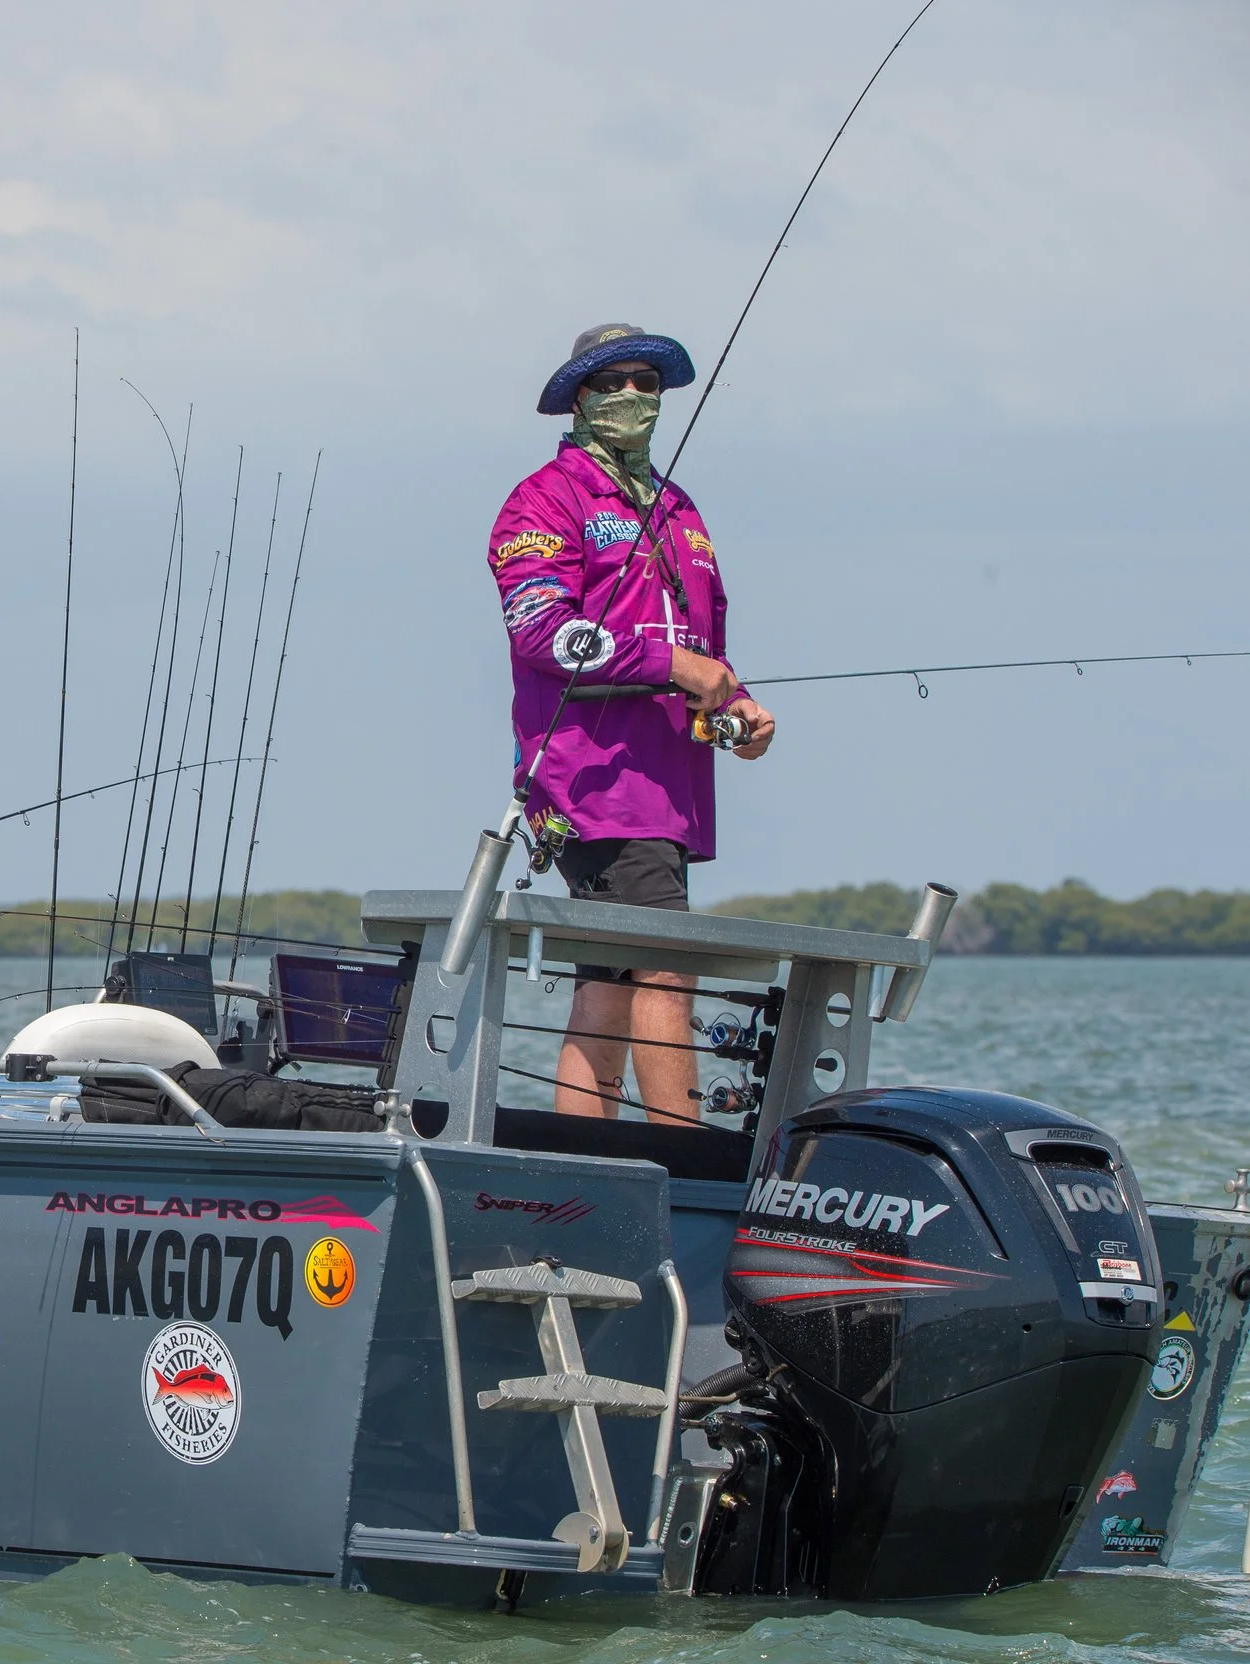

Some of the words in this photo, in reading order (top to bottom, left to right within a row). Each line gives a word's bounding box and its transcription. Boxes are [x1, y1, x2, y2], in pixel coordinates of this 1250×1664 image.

[585, 520, 641, 538] FLATHEAD
[1047, 1129, 1095, 1141] MERCURY
[45, 1190, 282, 1222] ANGLAPRO
[745, 1177, 950, 1237] MERCURY
[1055, 1183, 1124, 1216] 100
[748, 1226, 857, 1253] FOURSTROKE
[154, 1332, 222, 1367] GARDINER
[161, 1422, 228, 1454] FISHERIES
[1106, 1536, 1160, 1547] IRONMAN
